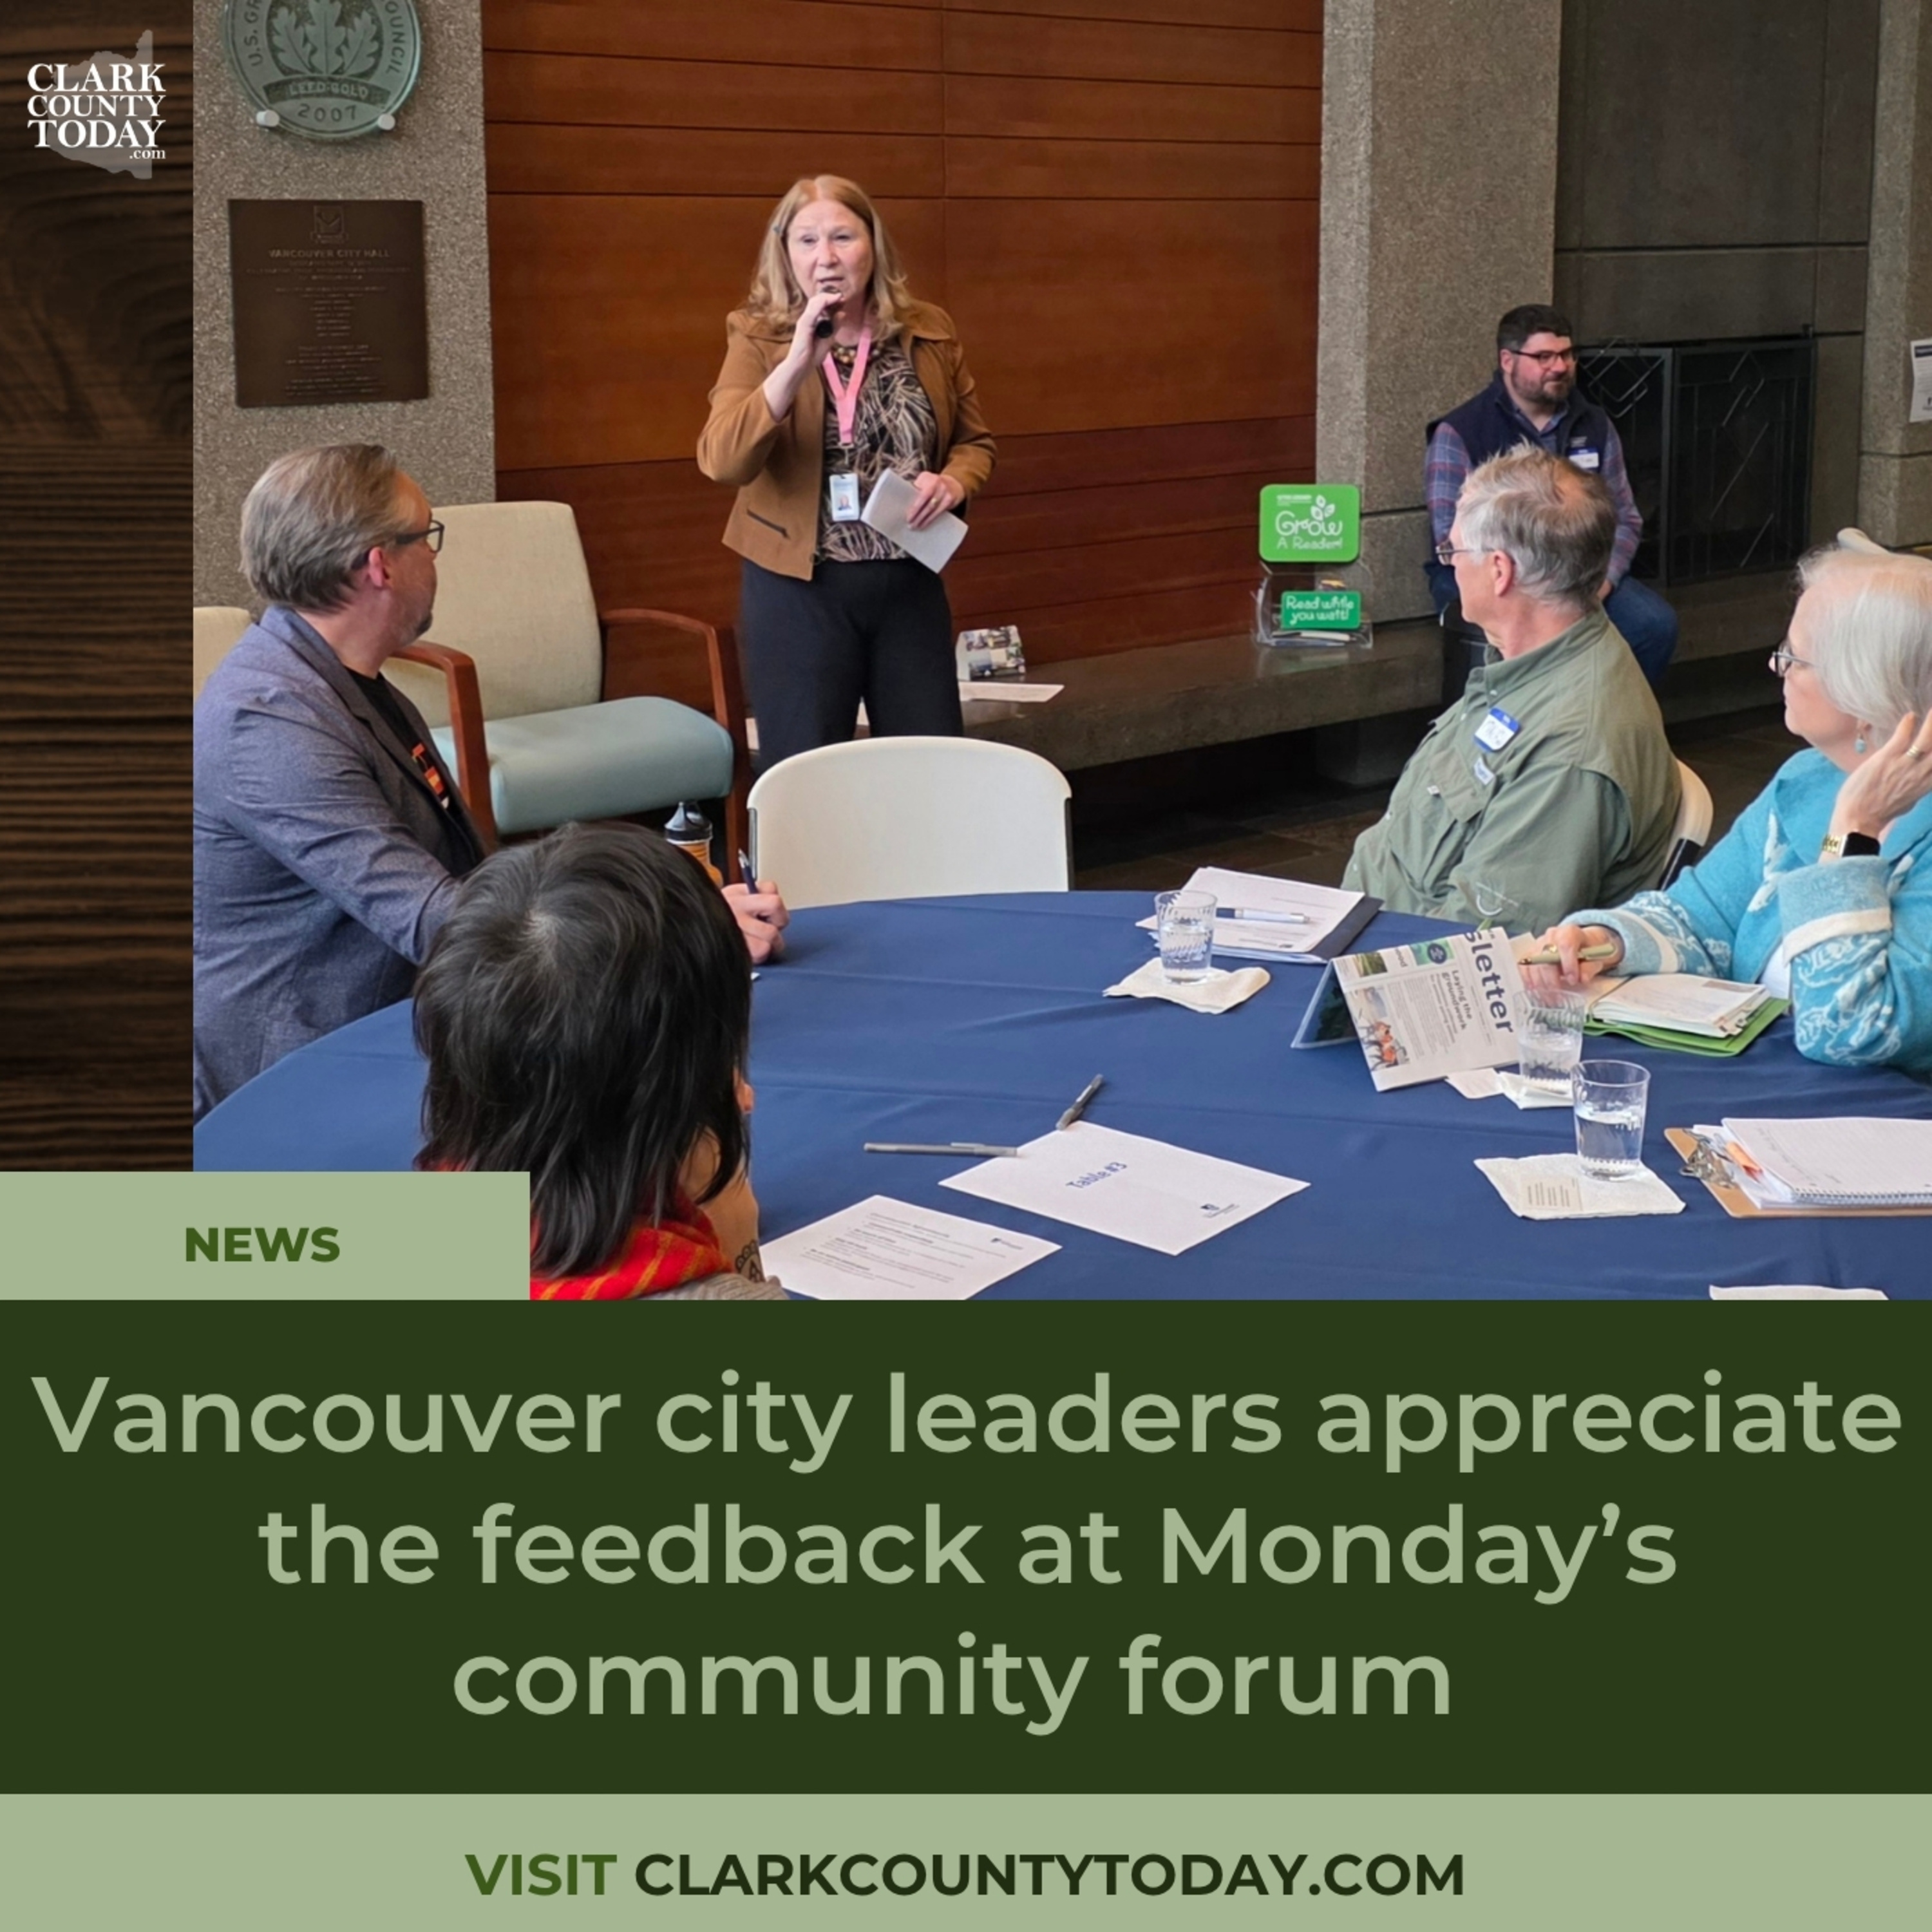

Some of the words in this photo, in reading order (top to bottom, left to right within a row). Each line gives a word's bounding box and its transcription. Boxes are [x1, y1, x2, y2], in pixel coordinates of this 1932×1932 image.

[384, 0, 406, 74] OUNCIL
[298, 103, 357, 122] 2007
[269, 249, 334, 258] VANCOUVER
[1275, 510, 1343, 536] Grow
[1276, 536, 1288, 549] A
[1286, 595, 1320, 609] Read
[1289, 612, 1314, 625] you
[1442, 971, 1468, 1030] groundwork
[1452, 970, 1467, 1005] Laying
[1463, 1003, 1473, 1019] the
[1065, 1172, 1111, 1188] Table
[1104, 1162, 1127, 1173] #3
